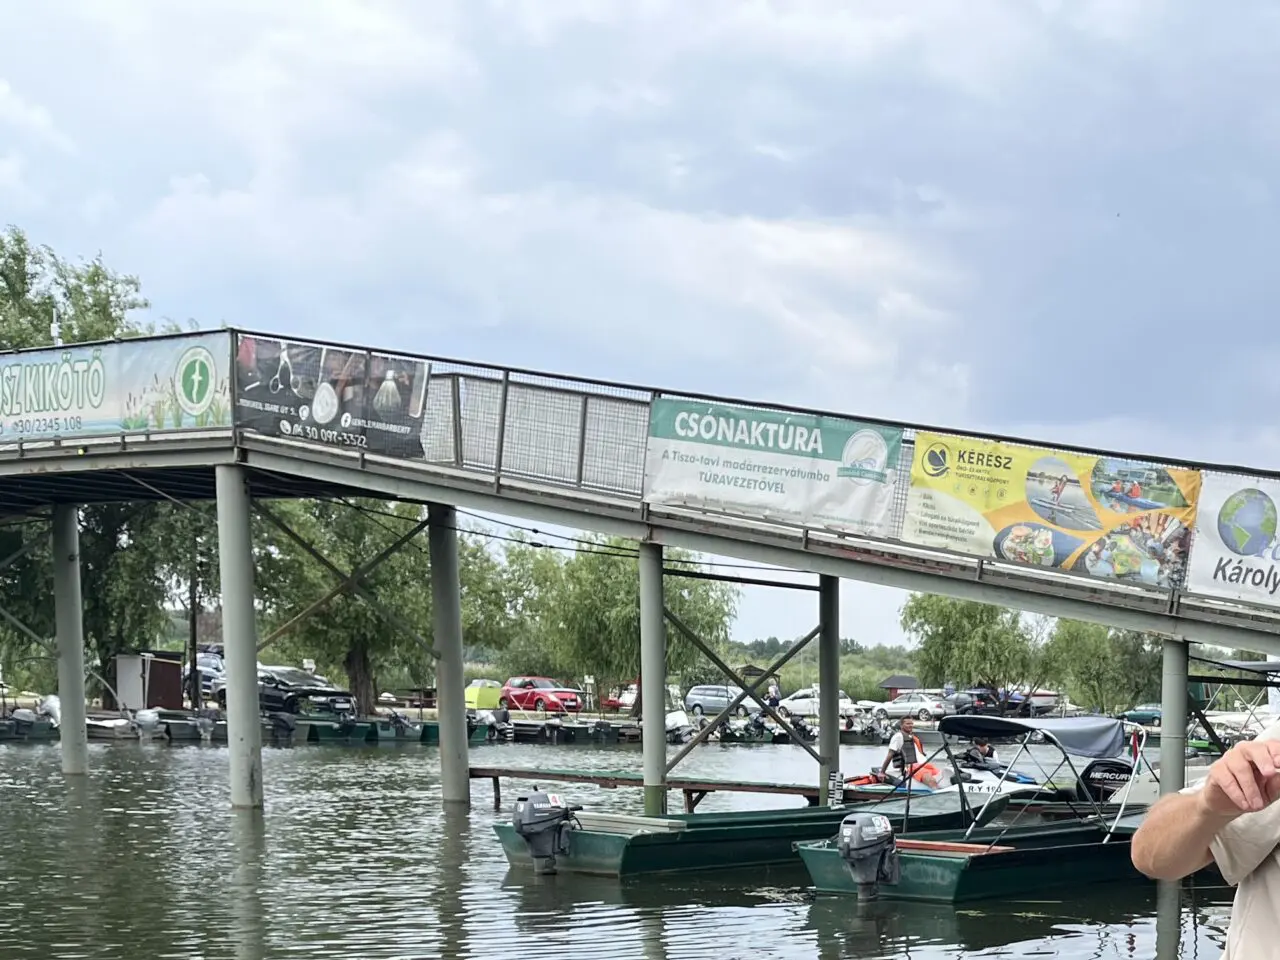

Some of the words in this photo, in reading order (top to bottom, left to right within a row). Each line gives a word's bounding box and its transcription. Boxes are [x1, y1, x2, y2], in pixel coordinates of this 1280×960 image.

[64, 416, 82, 431] 108
[305, 426, 318, 439] 30
[674, 408, 824, 454] CSÓNAKTÚRA
[661, 449, 670, 460] A
[672, 450, 719, 467] Tisza-tavi
[722, 459, 830, 482] madárrezervátumba
[957, 449, 1013, 470] KÉRÉSZ
